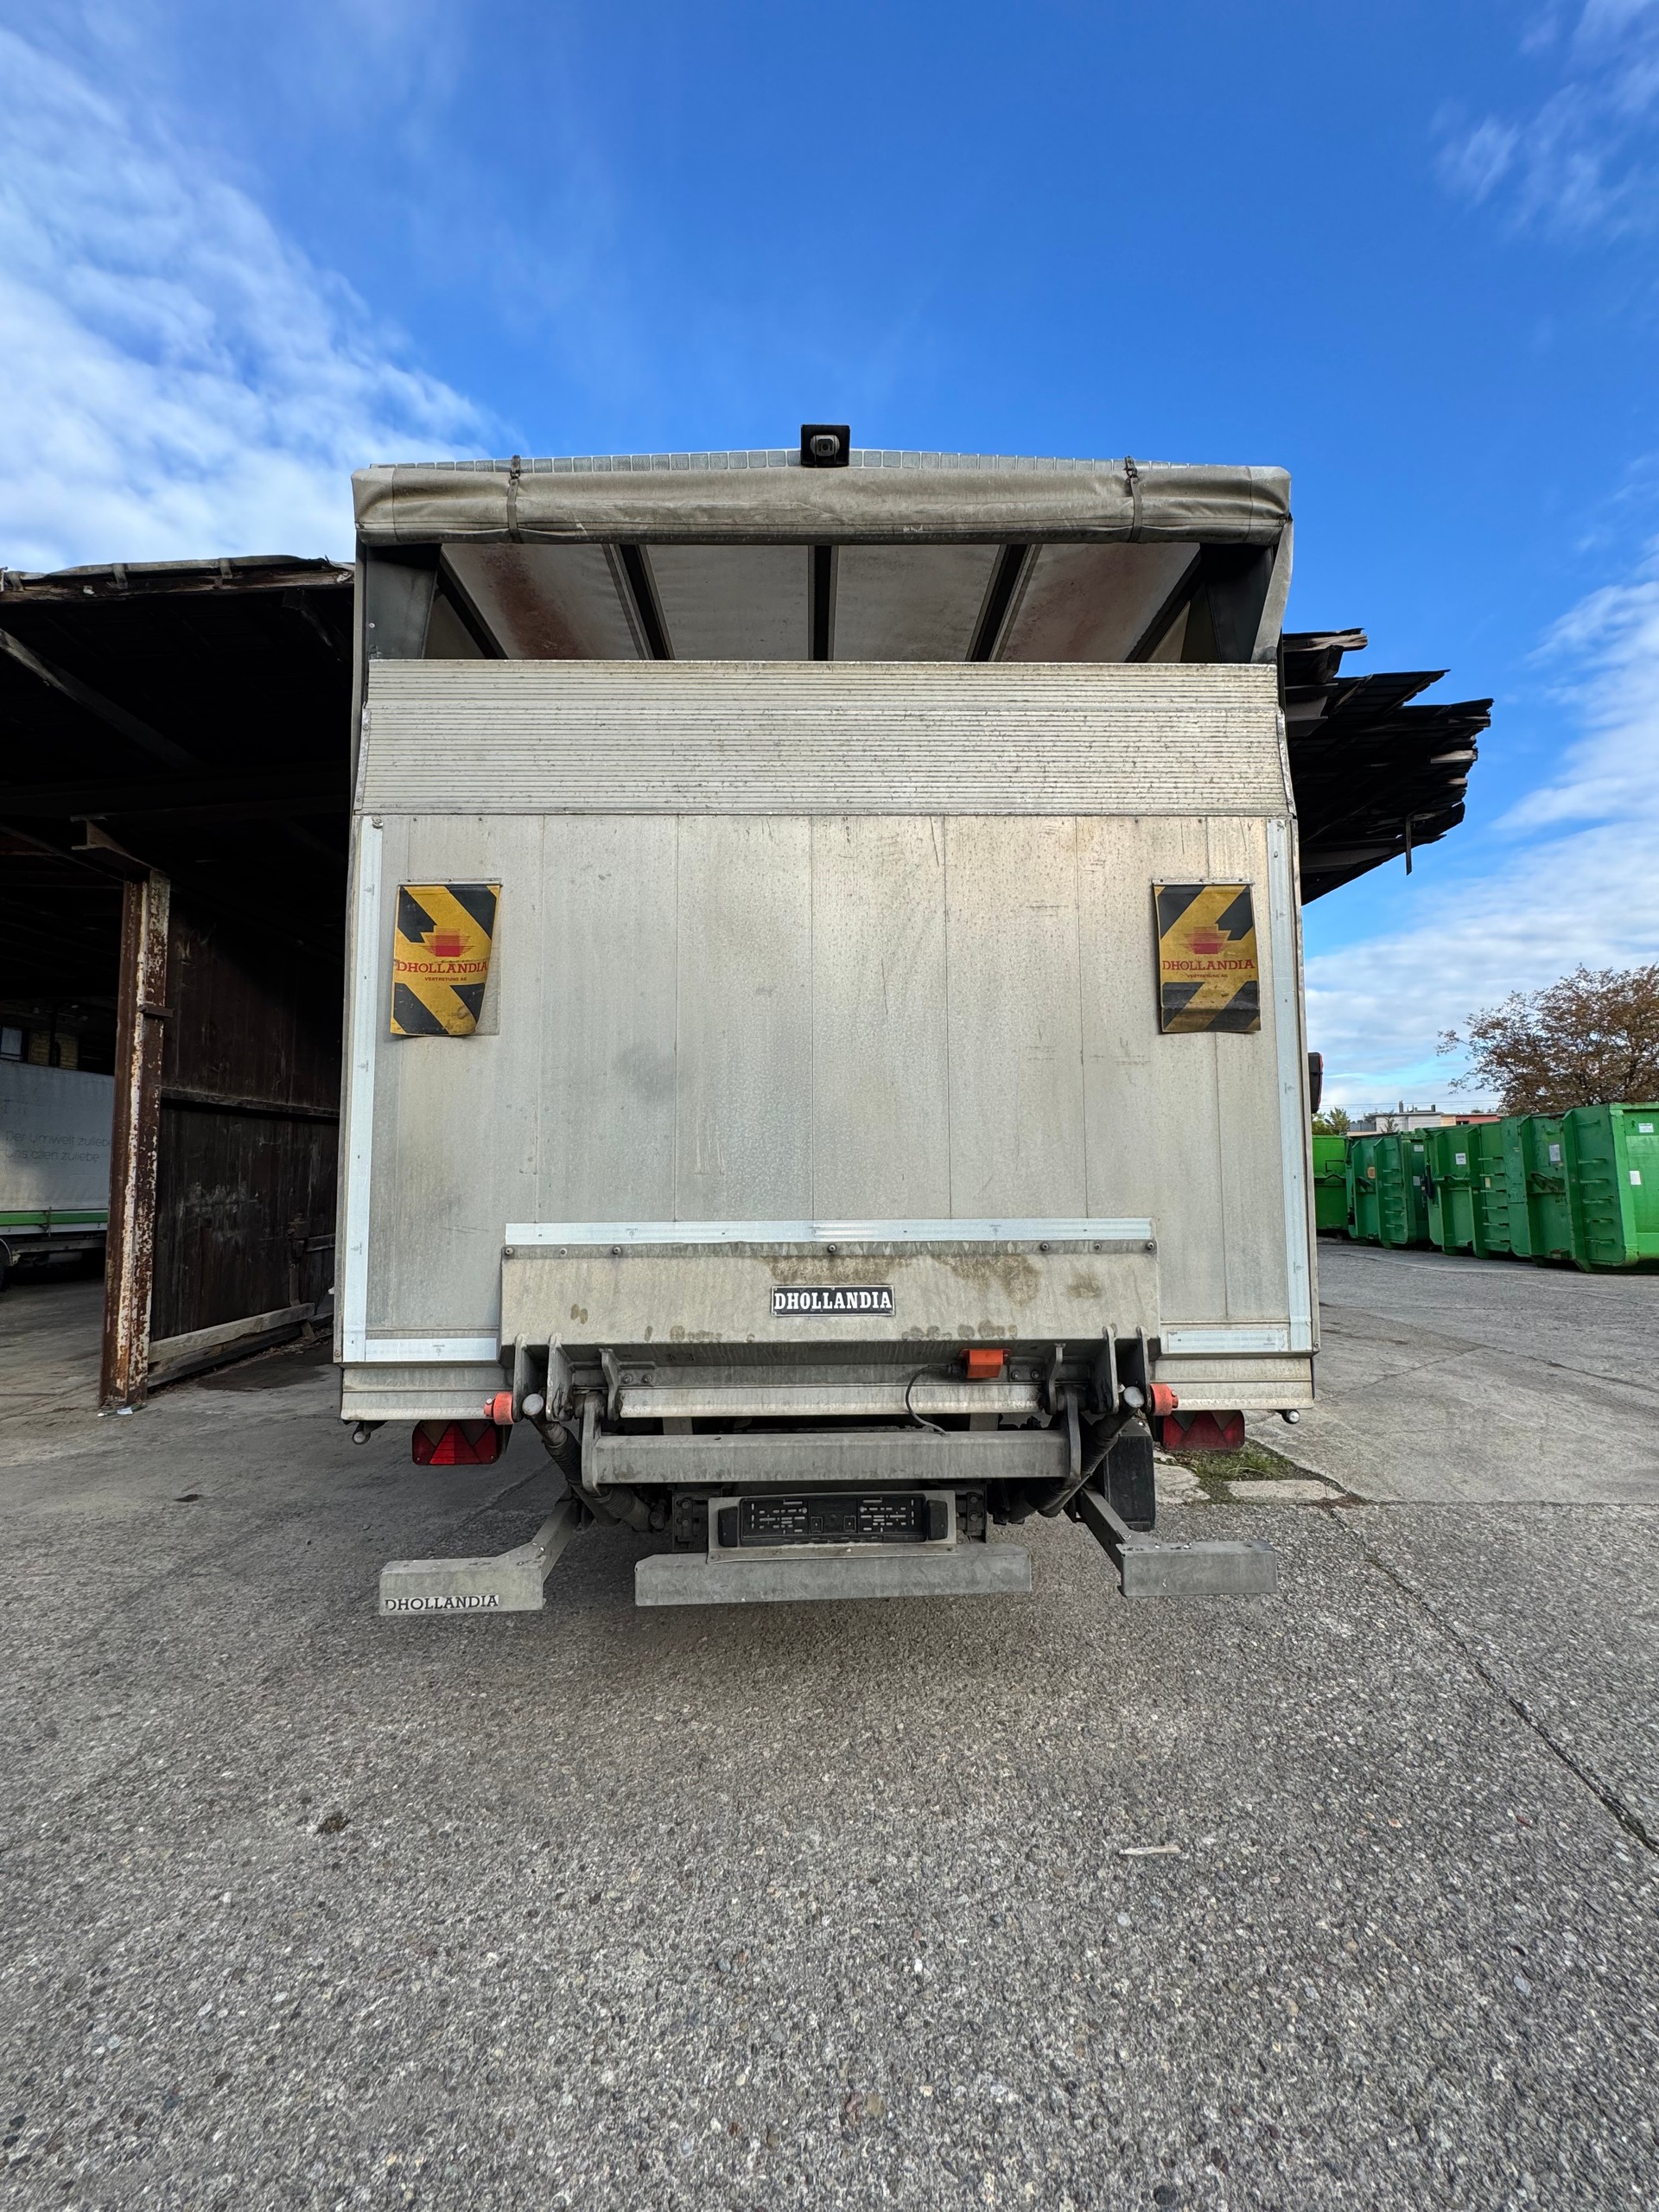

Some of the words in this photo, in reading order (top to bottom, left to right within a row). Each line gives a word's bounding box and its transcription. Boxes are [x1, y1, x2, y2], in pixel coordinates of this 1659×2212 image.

[397, 961, 487, 974] DHOLLANDIA
[1162, 959, 1255, 970] DHOLLANDIA
[5, 1130, 26, 1142] Der
[29, 1132, 75, 1145] Umwelt
[30, 1149, 58, 1160] allen
[60, 1151, 100, 1162] zuliebe
[774, 1291, 893, 1310] DHOLLANDIA
[385, 1595, 498, 1611] DHOLLANDIA
